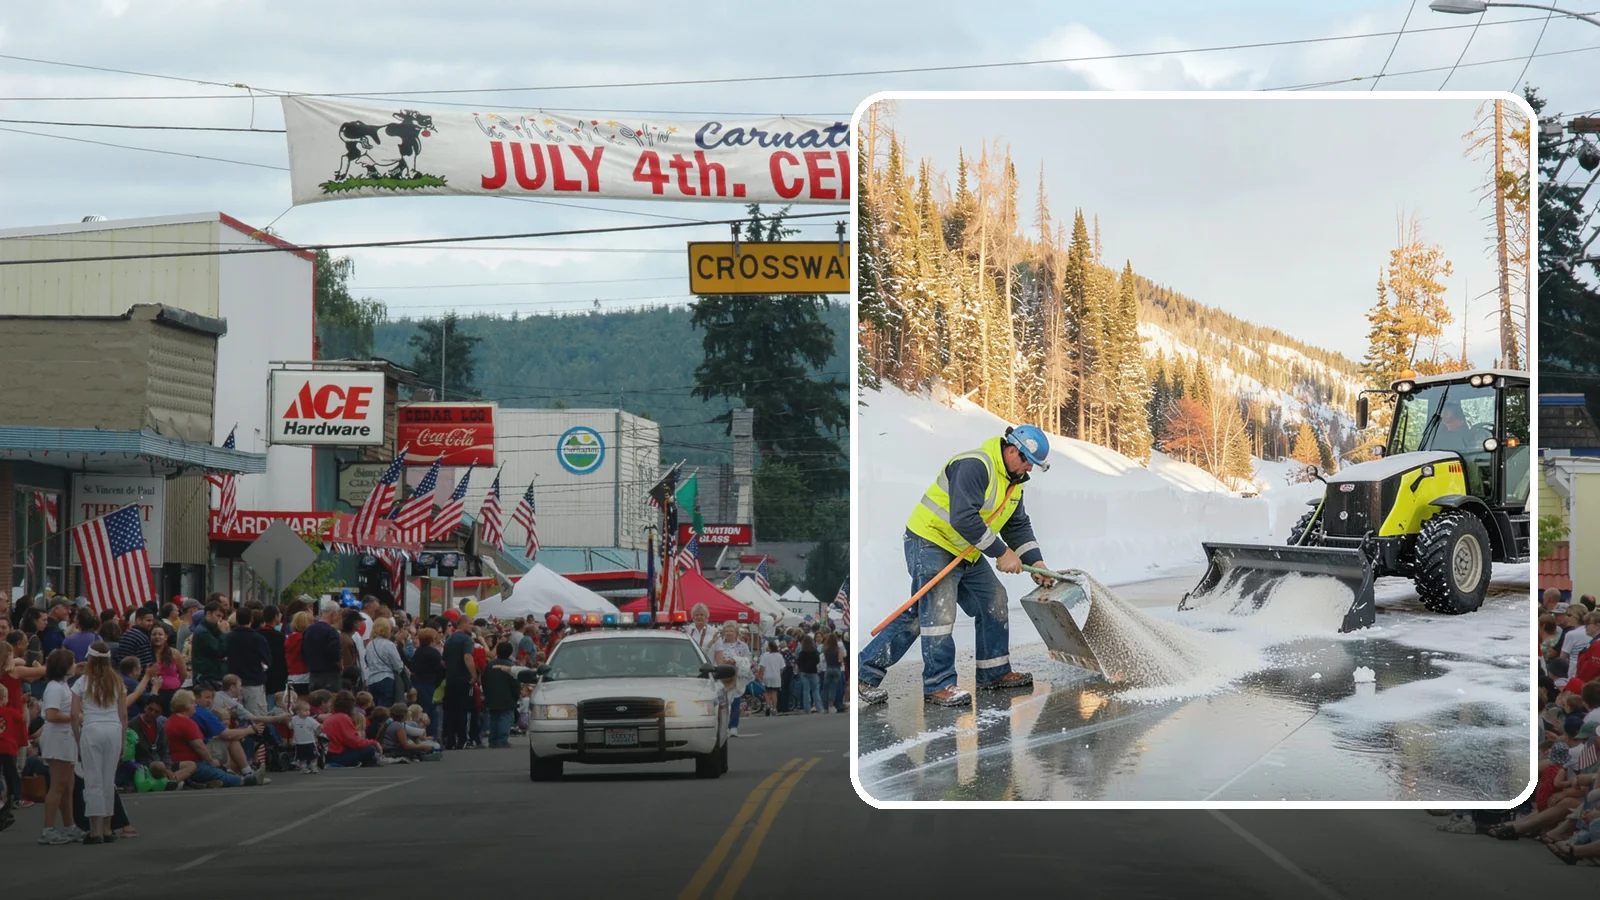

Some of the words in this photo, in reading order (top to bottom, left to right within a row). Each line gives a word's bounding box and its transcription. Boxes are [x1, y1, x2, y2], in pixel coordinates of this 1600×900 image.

[695, 121, 850, 150] Carnat
[481, 141, 604, 192] JULY
[632, 150, 746, 198] 4th.
[696, 254, 850, 280] CROSSWA
[283, 380, 374, 420] ACE
[405, 409, 453, 422] CEDAR
[283, 421, 371, 436] Hardware
[416, 428, 477, 447] Coca-Cola
[83, 484, 94, 494] St.
[96, 485, 124, 495] Vincent
[126, 486, 136, 495] de
[137, 486, 155, 495] Paul
[688, 526, 741, 535] CRNATION
[700, 535, 730, 543] GLASS
